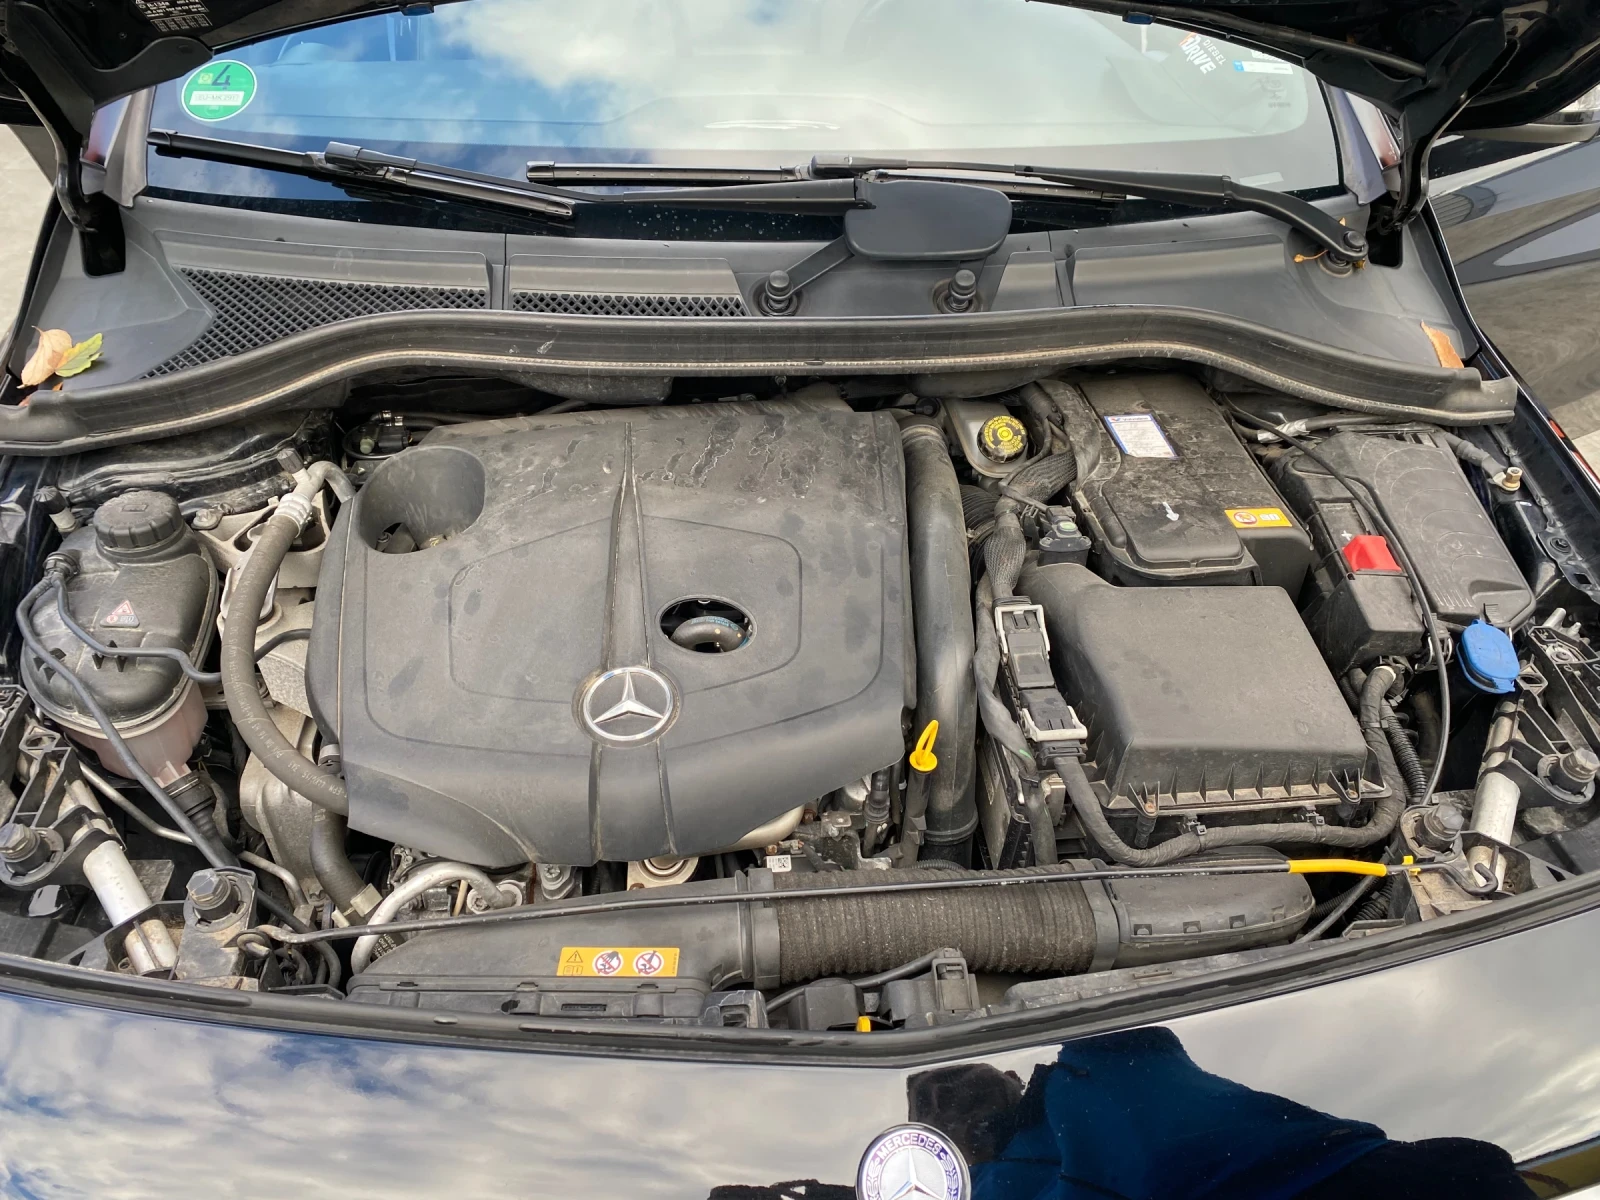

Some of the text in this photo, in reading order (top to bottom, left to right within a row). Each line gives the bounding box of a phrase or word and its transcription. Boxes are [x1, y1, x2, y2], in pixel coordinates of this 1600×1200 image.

[1203, 39, 1227, 65] DIESEL
[211, 64, 231, 90] 4
[876, 1133, 942, 1159] MERCEDES
